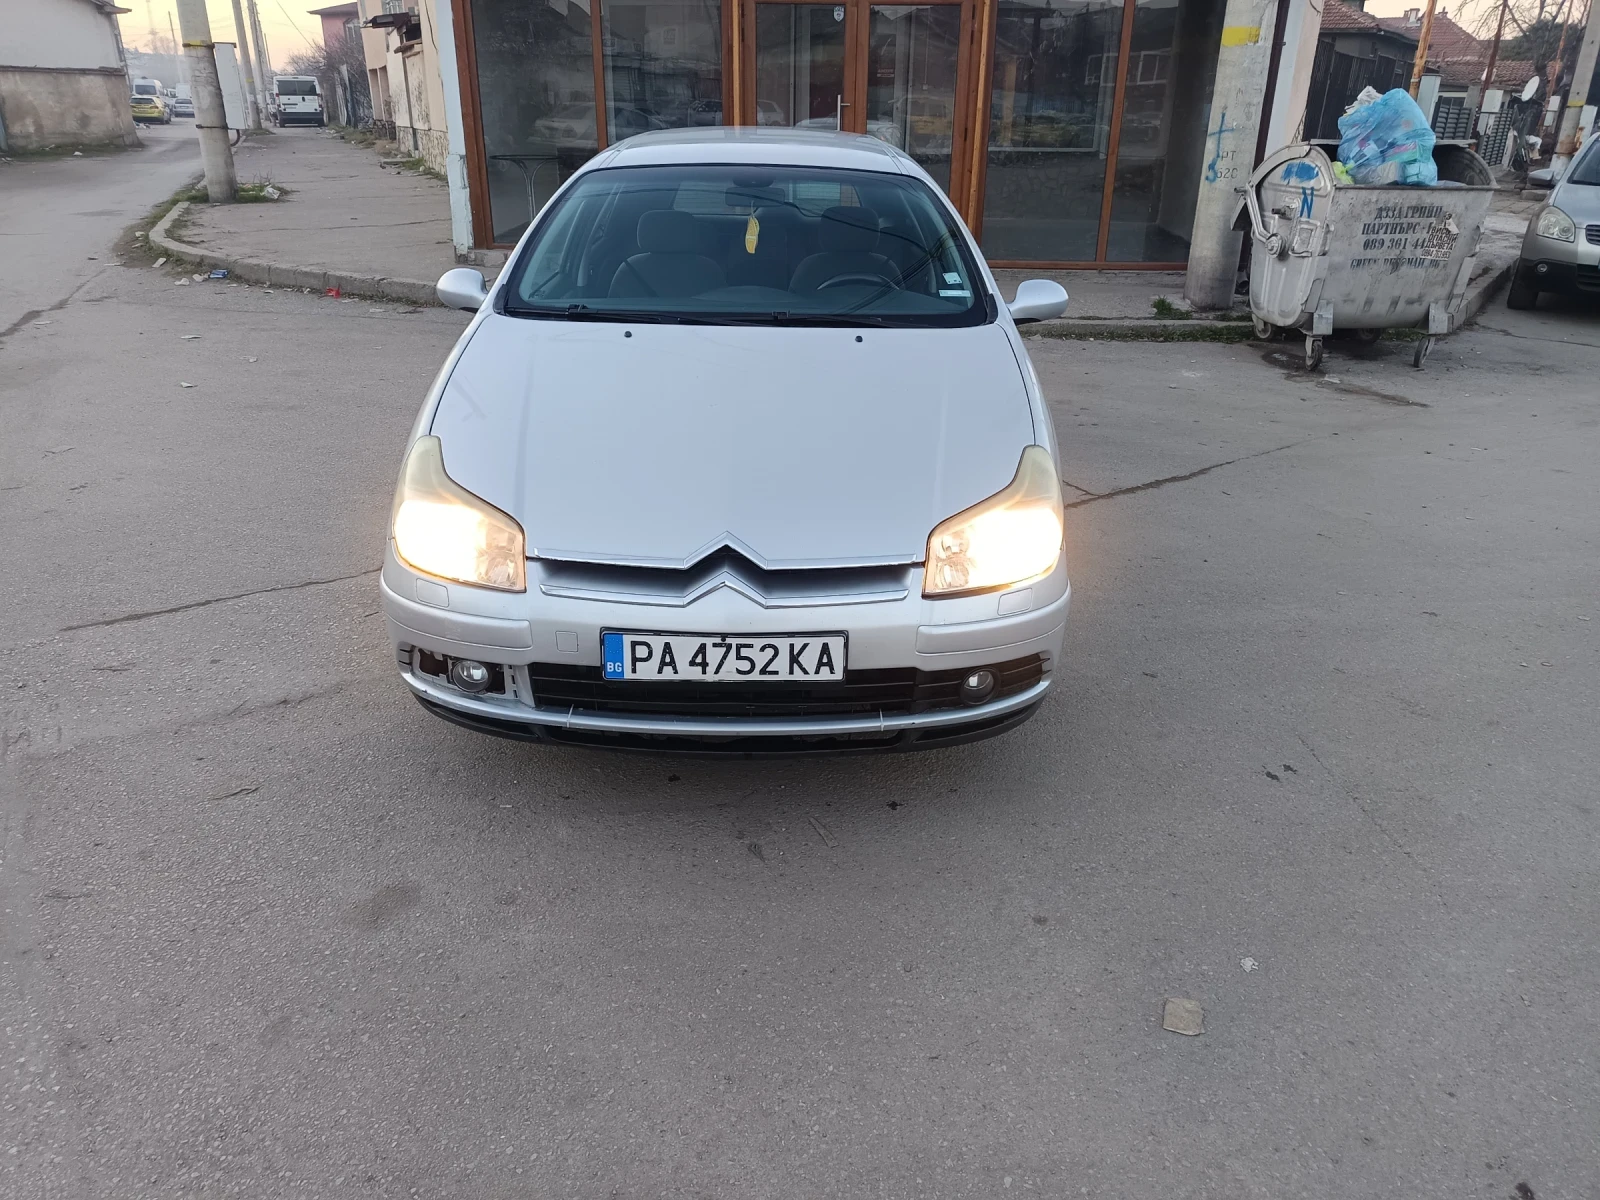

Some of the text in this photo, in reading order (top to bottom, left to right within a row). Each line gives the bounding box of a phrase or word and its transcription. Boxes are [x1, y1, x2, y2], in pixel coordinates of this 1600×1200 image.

[1361, 222, 1420, 235] ПАРТНЪРС
[1363, 238, 1385, 250] 089
[1387, 238, 1408, 250] 361
[630, 641, 836, 676] PA 4752 KA
[606, 662, 623, 673] BG
